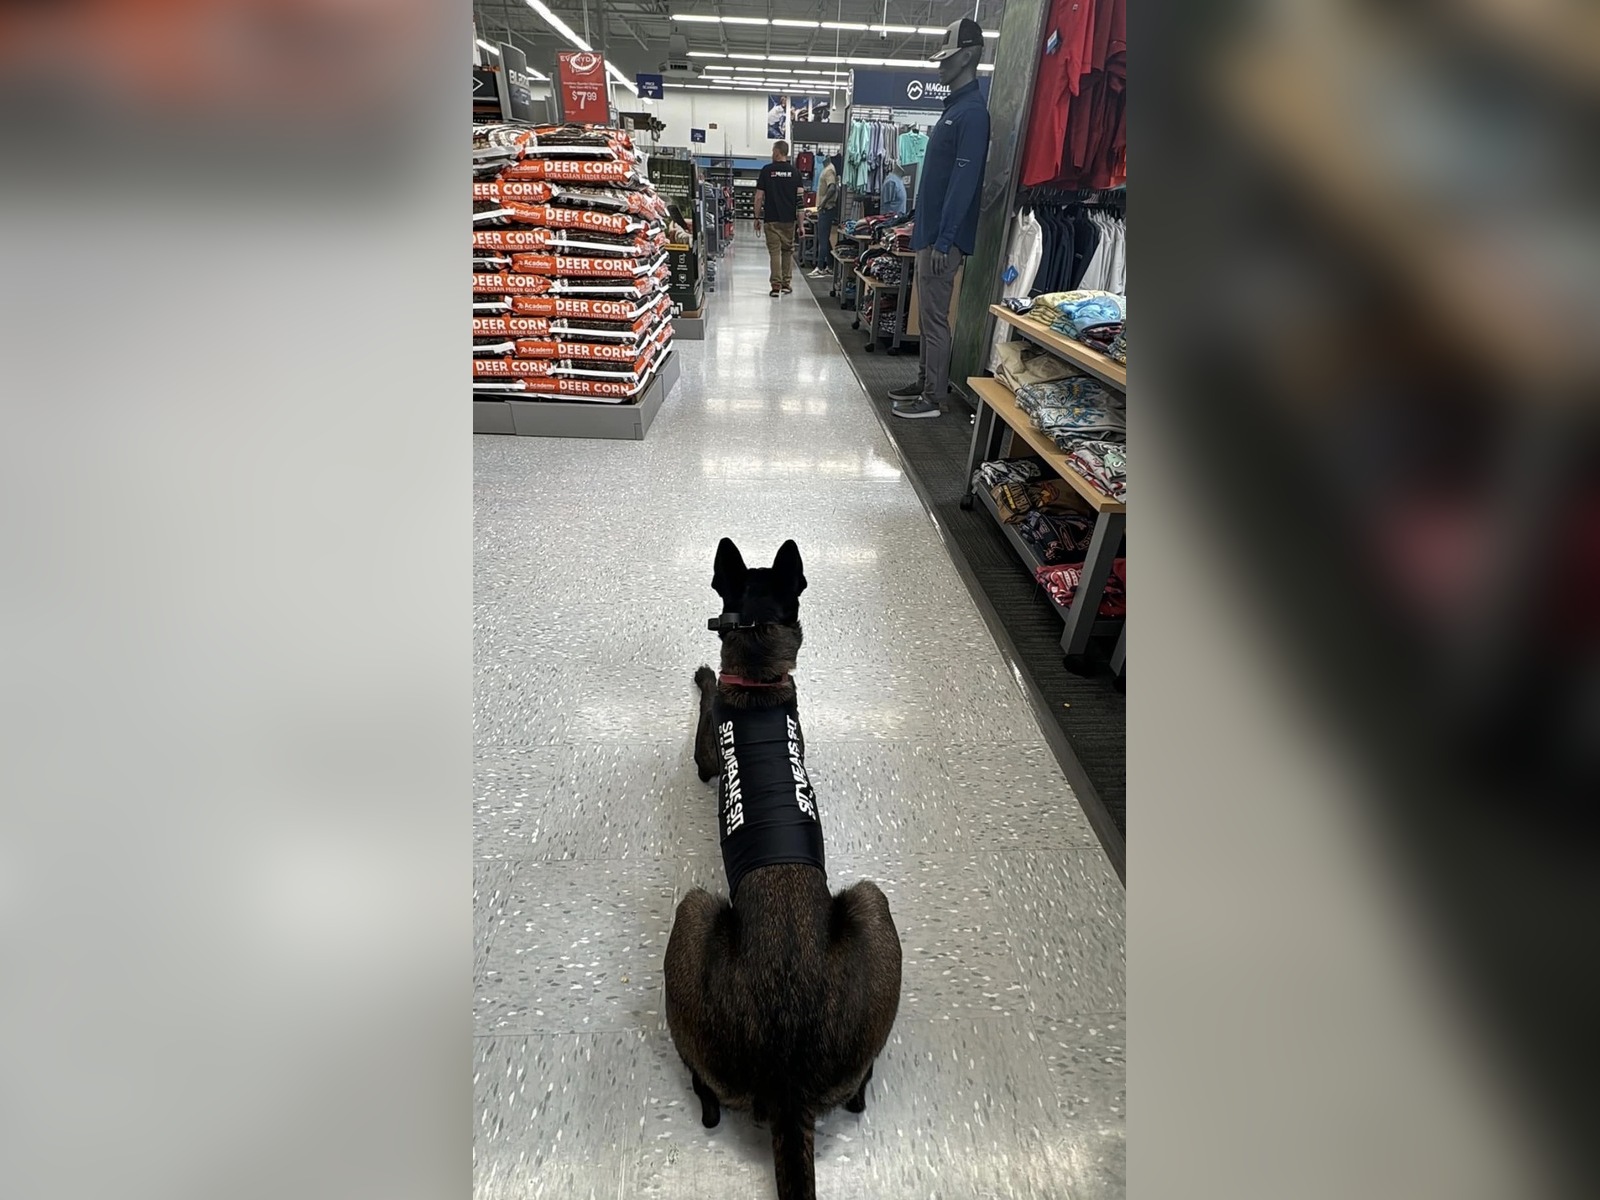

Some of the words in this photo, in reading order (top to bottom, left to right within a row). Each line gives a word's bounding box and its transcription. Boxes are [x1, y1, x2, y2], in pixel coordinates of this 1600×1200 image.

[544, 161, 579, 173] DEER
[584, 162, 623, 174] CORN
[502, 184, 544, 195] CORN
[546, 210, 579, 221] DEER
[582, 214, 622, 228] CORN
[506, 233, 545, 244] CORN
[556, 258, 590, 270] DEER
[594, 260, 633, 271] CORN
[556, 301, 588, 312] DEER
[593, 302, 631, 314] CORN
[473, 320, 506, 330] DEER
[510, 320, 547, 330] CORN
[558, 344, 590, 356] DEER
[476, 362, 508, 372] DEER
[512, 362, 548, 372] CORN
[559, 381, 590, 392] DEER
[594, 383, 630, 394] CORN
[722, 720, 734, 745] SIT
[730, 802, 744, 831] SIT
